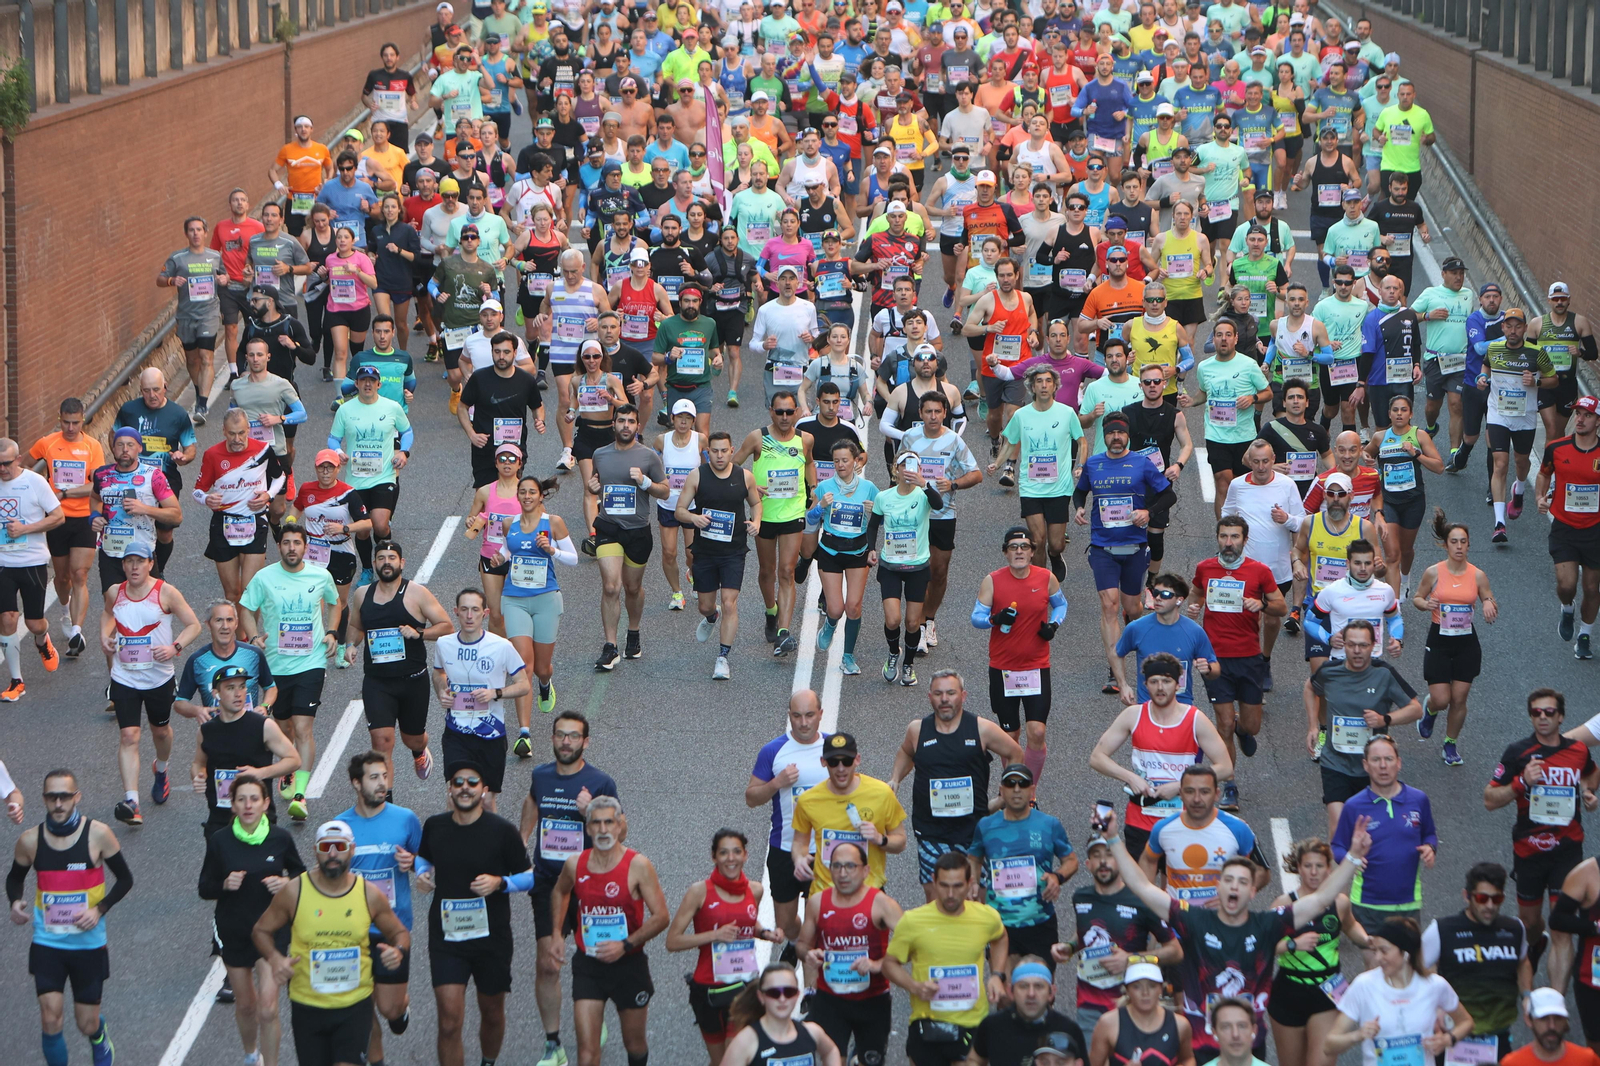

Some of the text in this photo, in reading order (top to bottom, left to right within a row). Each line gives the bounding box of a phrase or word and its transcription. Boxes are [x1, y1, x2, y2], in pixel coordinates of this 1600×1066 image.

[458, 649, 477, 661] ROB
[837, 832, 862, 840] ZURICH
[828, 936, 868, 946] LAWDE
[328, 951, 354, 959] ZURICH
[1453, 944, 1518, 963] TRIVALL
